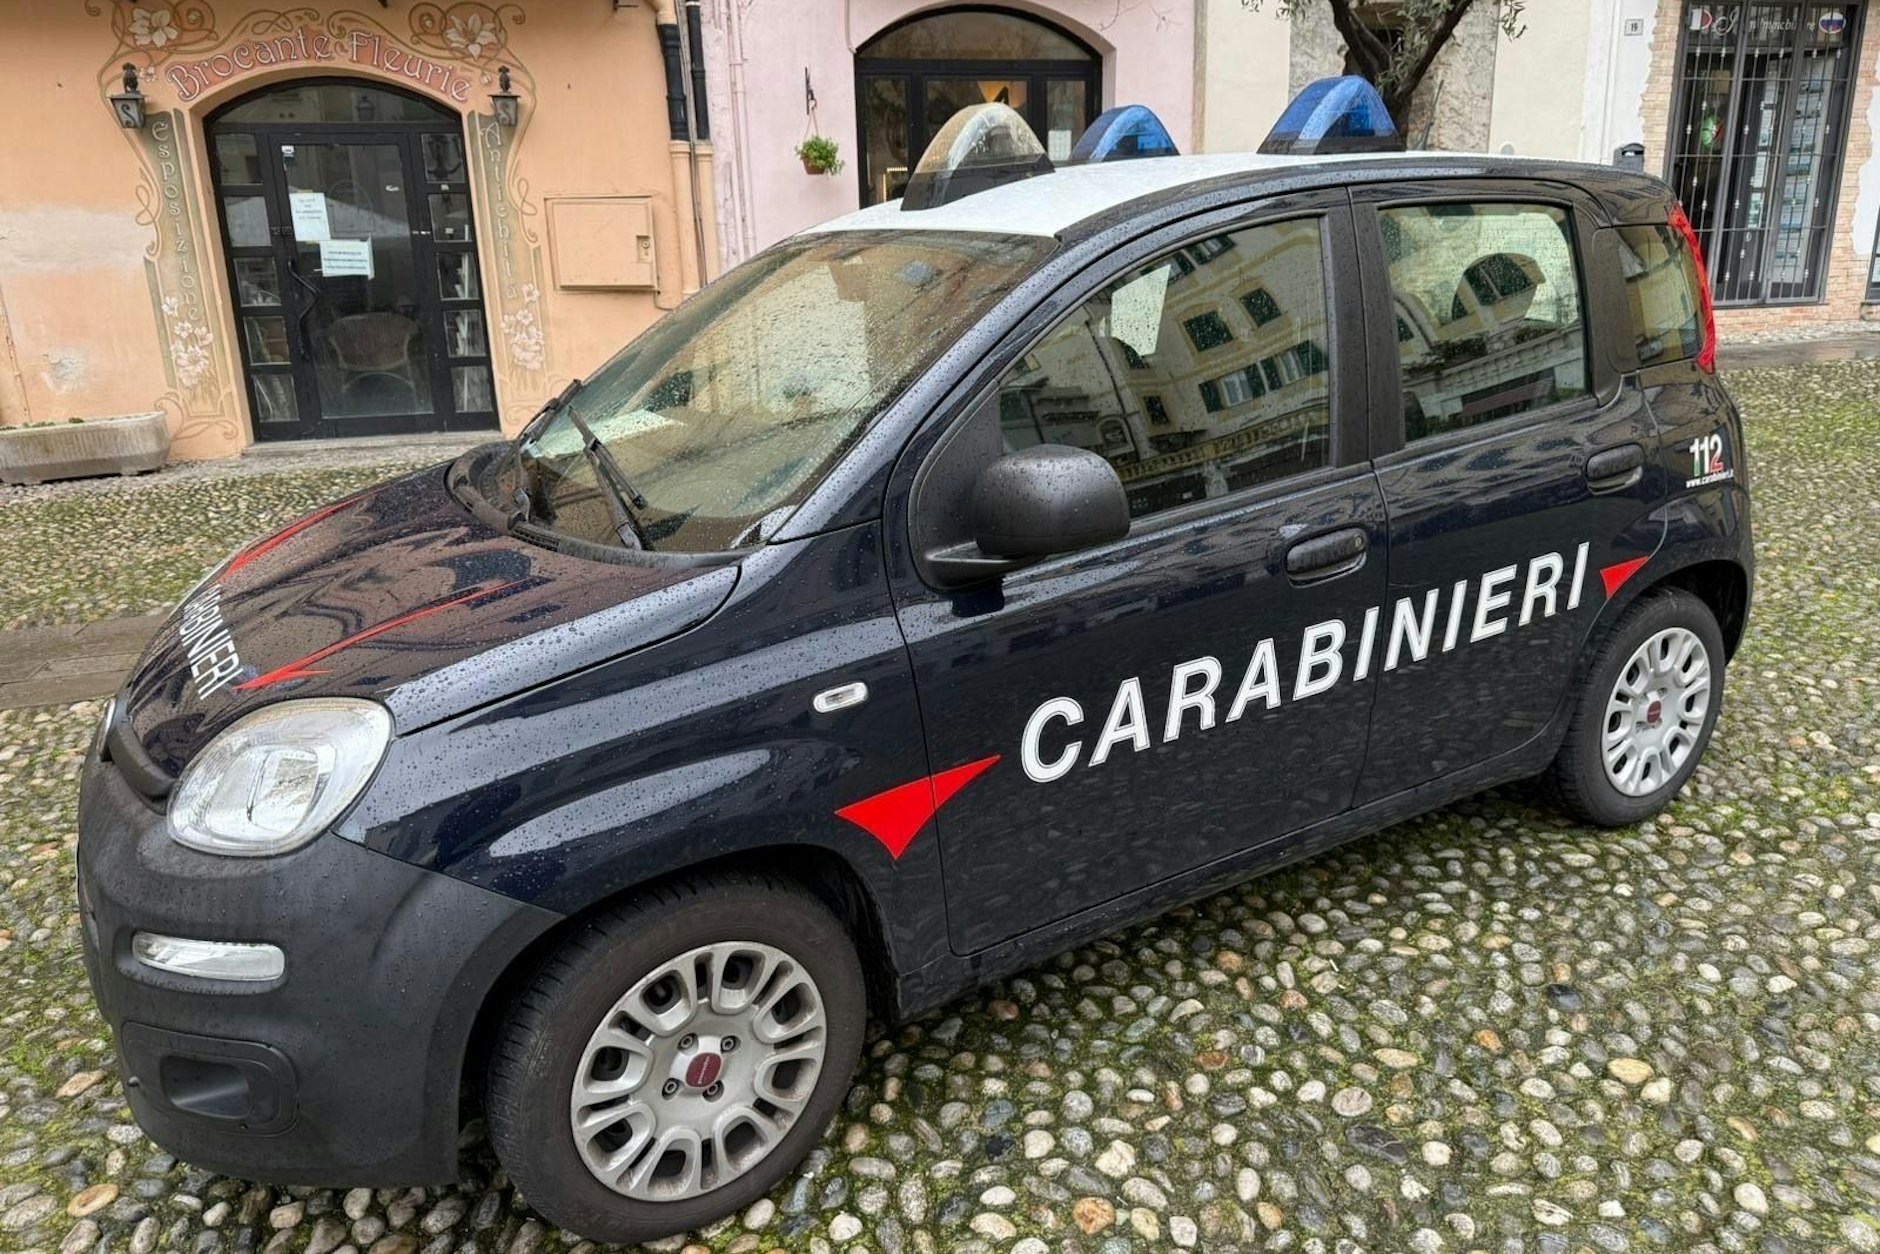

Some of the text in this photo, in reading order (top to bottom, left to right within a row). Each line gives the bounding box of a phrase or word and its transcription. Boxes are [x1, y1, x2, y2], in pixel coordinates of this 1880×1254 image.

[166, 27, 472, 101] Brocante Fleurie
[1631, 22, 1639, 32] 19
[152, 121, 202, 320] Esposizione
[1689, 433, 1724, 477] 112
[1020, 541, 1590, 783] CARABINIERI
